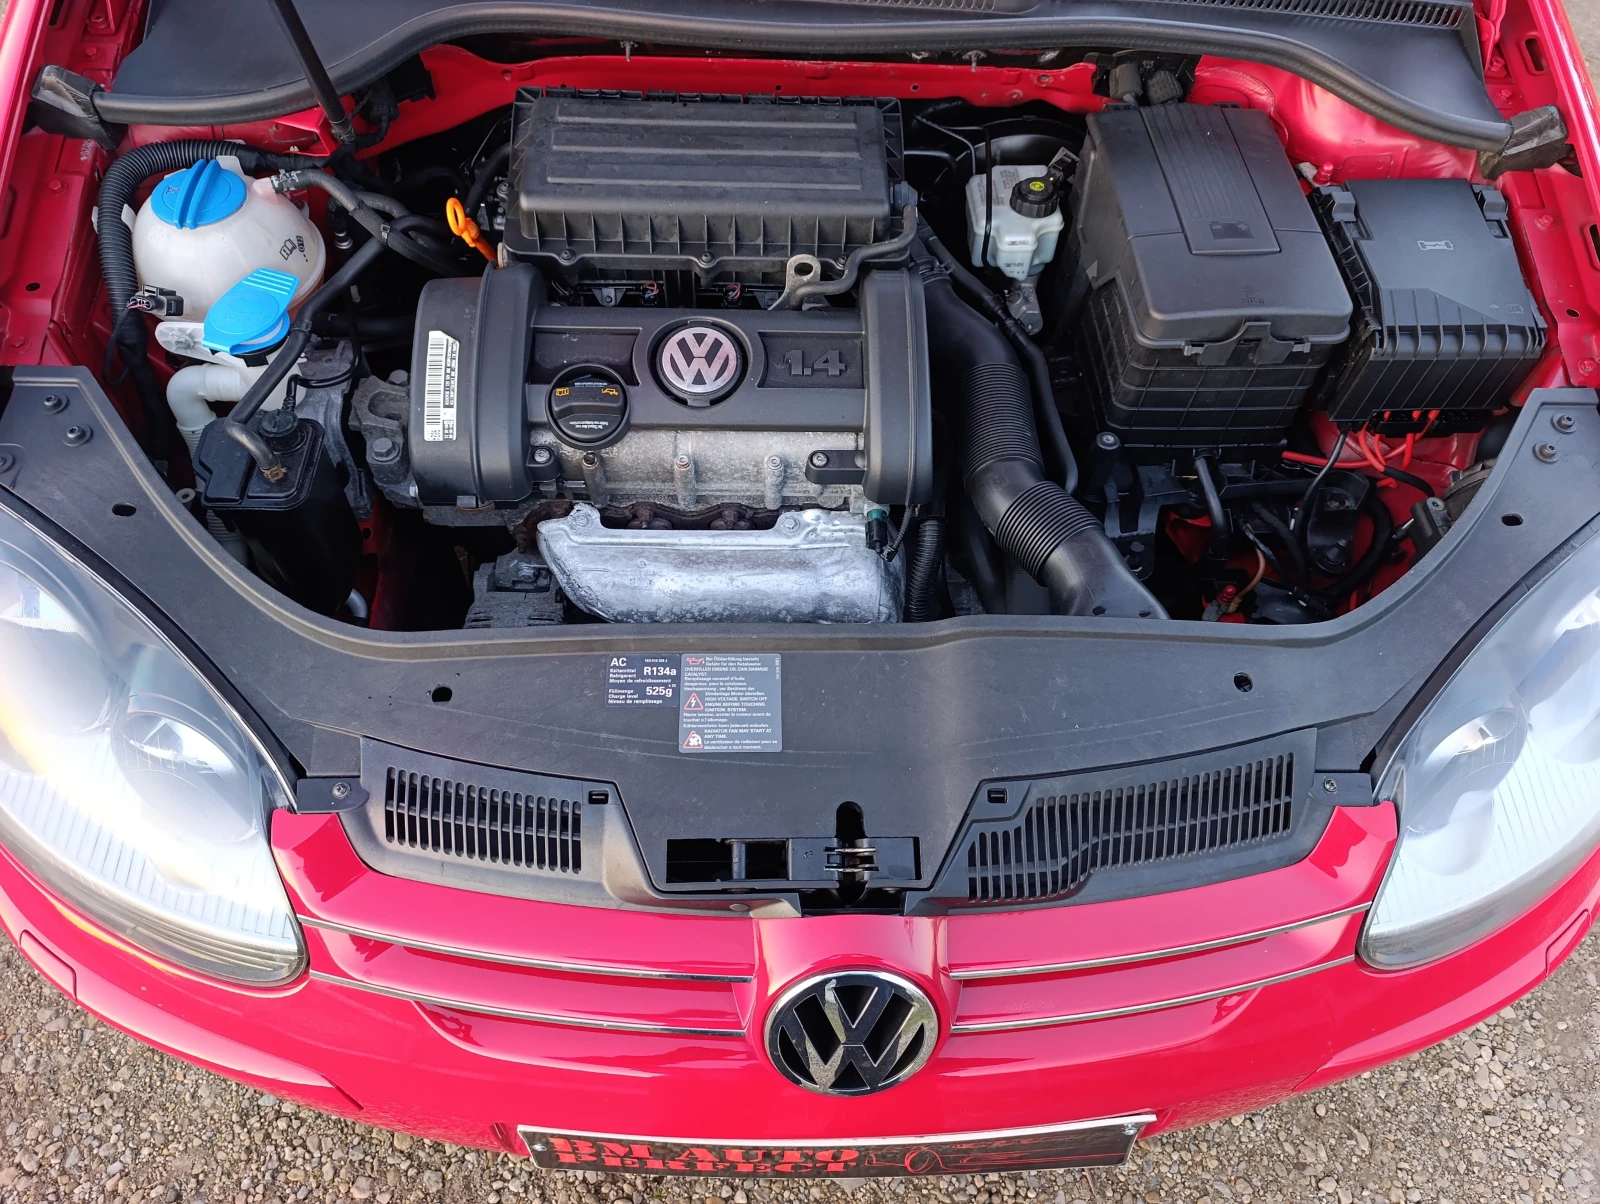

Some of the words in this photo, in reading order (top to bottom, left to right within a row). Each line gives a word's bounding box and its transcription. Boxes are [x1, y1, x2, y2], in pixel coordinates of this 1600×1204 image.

[783, 349, 846, 376] 1.4
[610, 658, 627, 666] AC
[644, 666, 676, 675] R134a
[646, 686, 672, 697] 525g
[764, 970, 939, 1097] VW
[547, 1136, 654, 1159] BM
[555, 1152, 857, 1173] PERFECT
